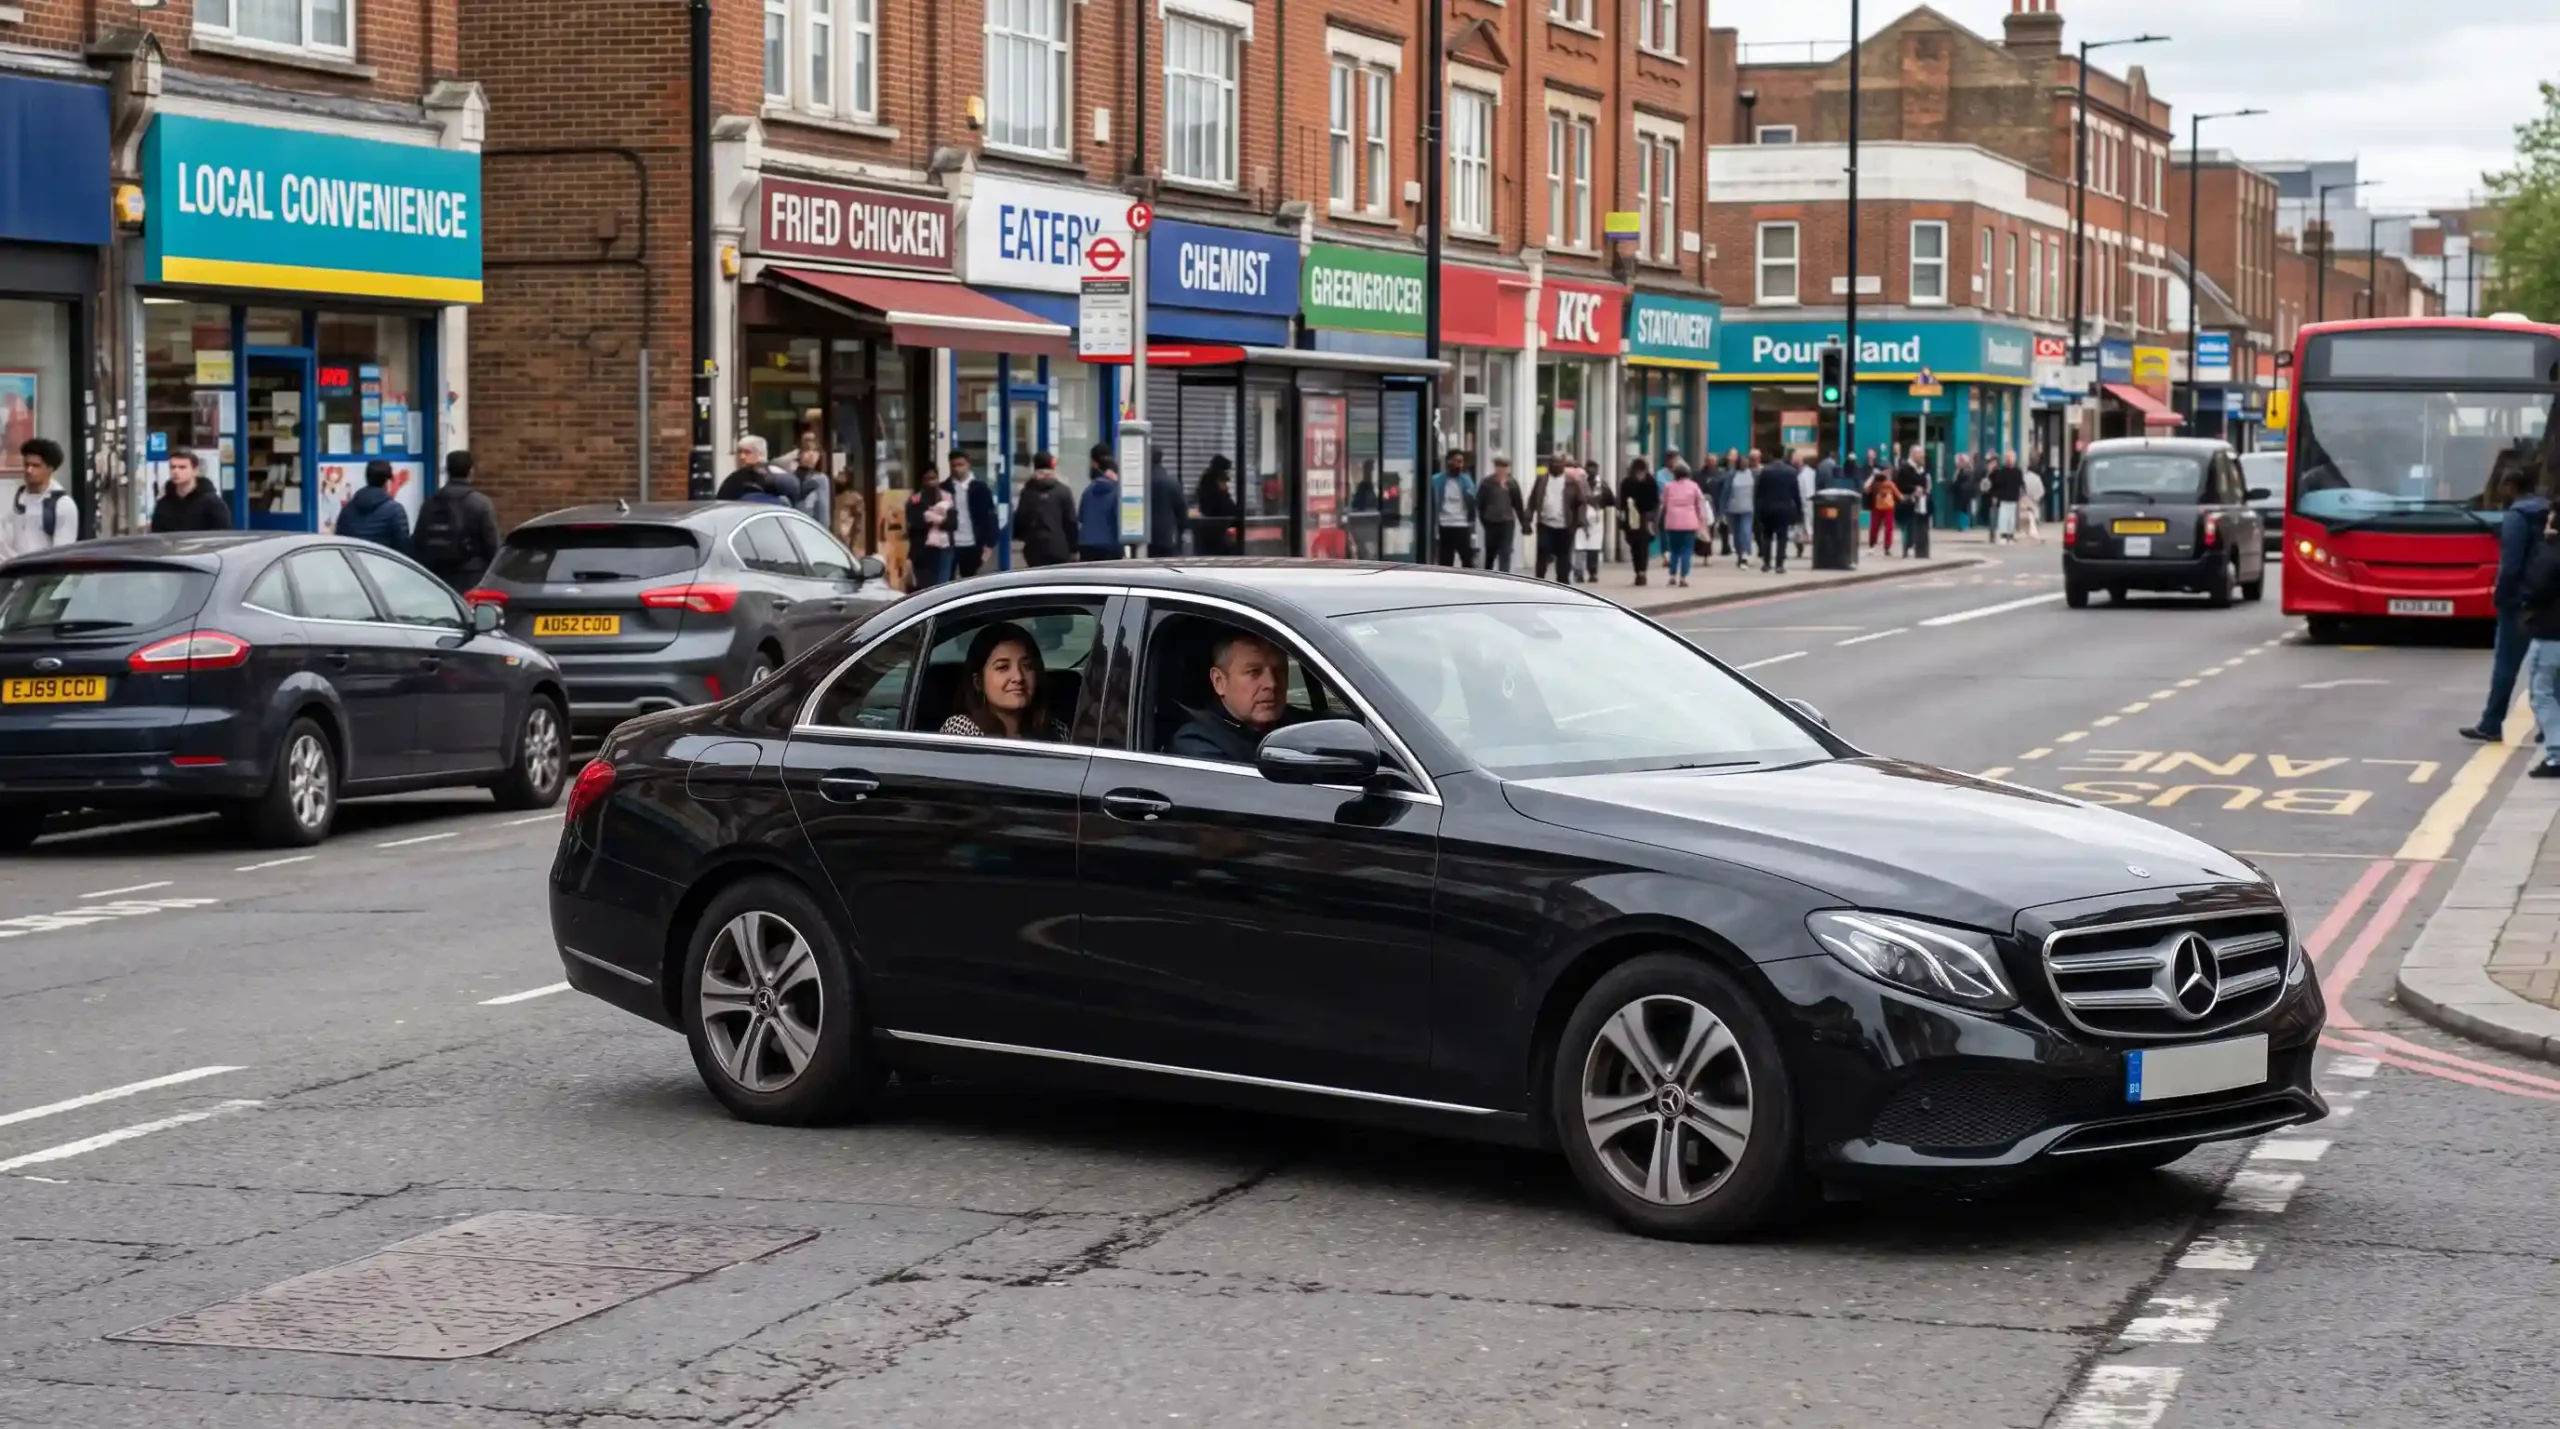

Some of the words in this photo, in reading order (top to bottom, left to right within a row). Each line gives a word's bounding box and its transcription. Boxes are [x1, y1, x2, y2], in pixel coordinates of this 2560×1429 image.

[178, 162, 273, 220] LOCAL
[281, 173, 468, 239] CONVENIENCE
[1132, 206, 1146, 228] C
[771, 192, 841, 246] FRIED
[848, 202, 945, 258] CHICKEN
[1179, 241, 1270, 296] CHEMIST
[1311, 266, 1422, 315] GREENGROCER
[1555, 291, 1602, 344] KFC
[1637, 308, 1712, 350] STATIONERY
[12, 680, 57, 698] EJ69
[2058, 748, 2442, 784] LANE
[2061, 781, 2375, 816] BUS
